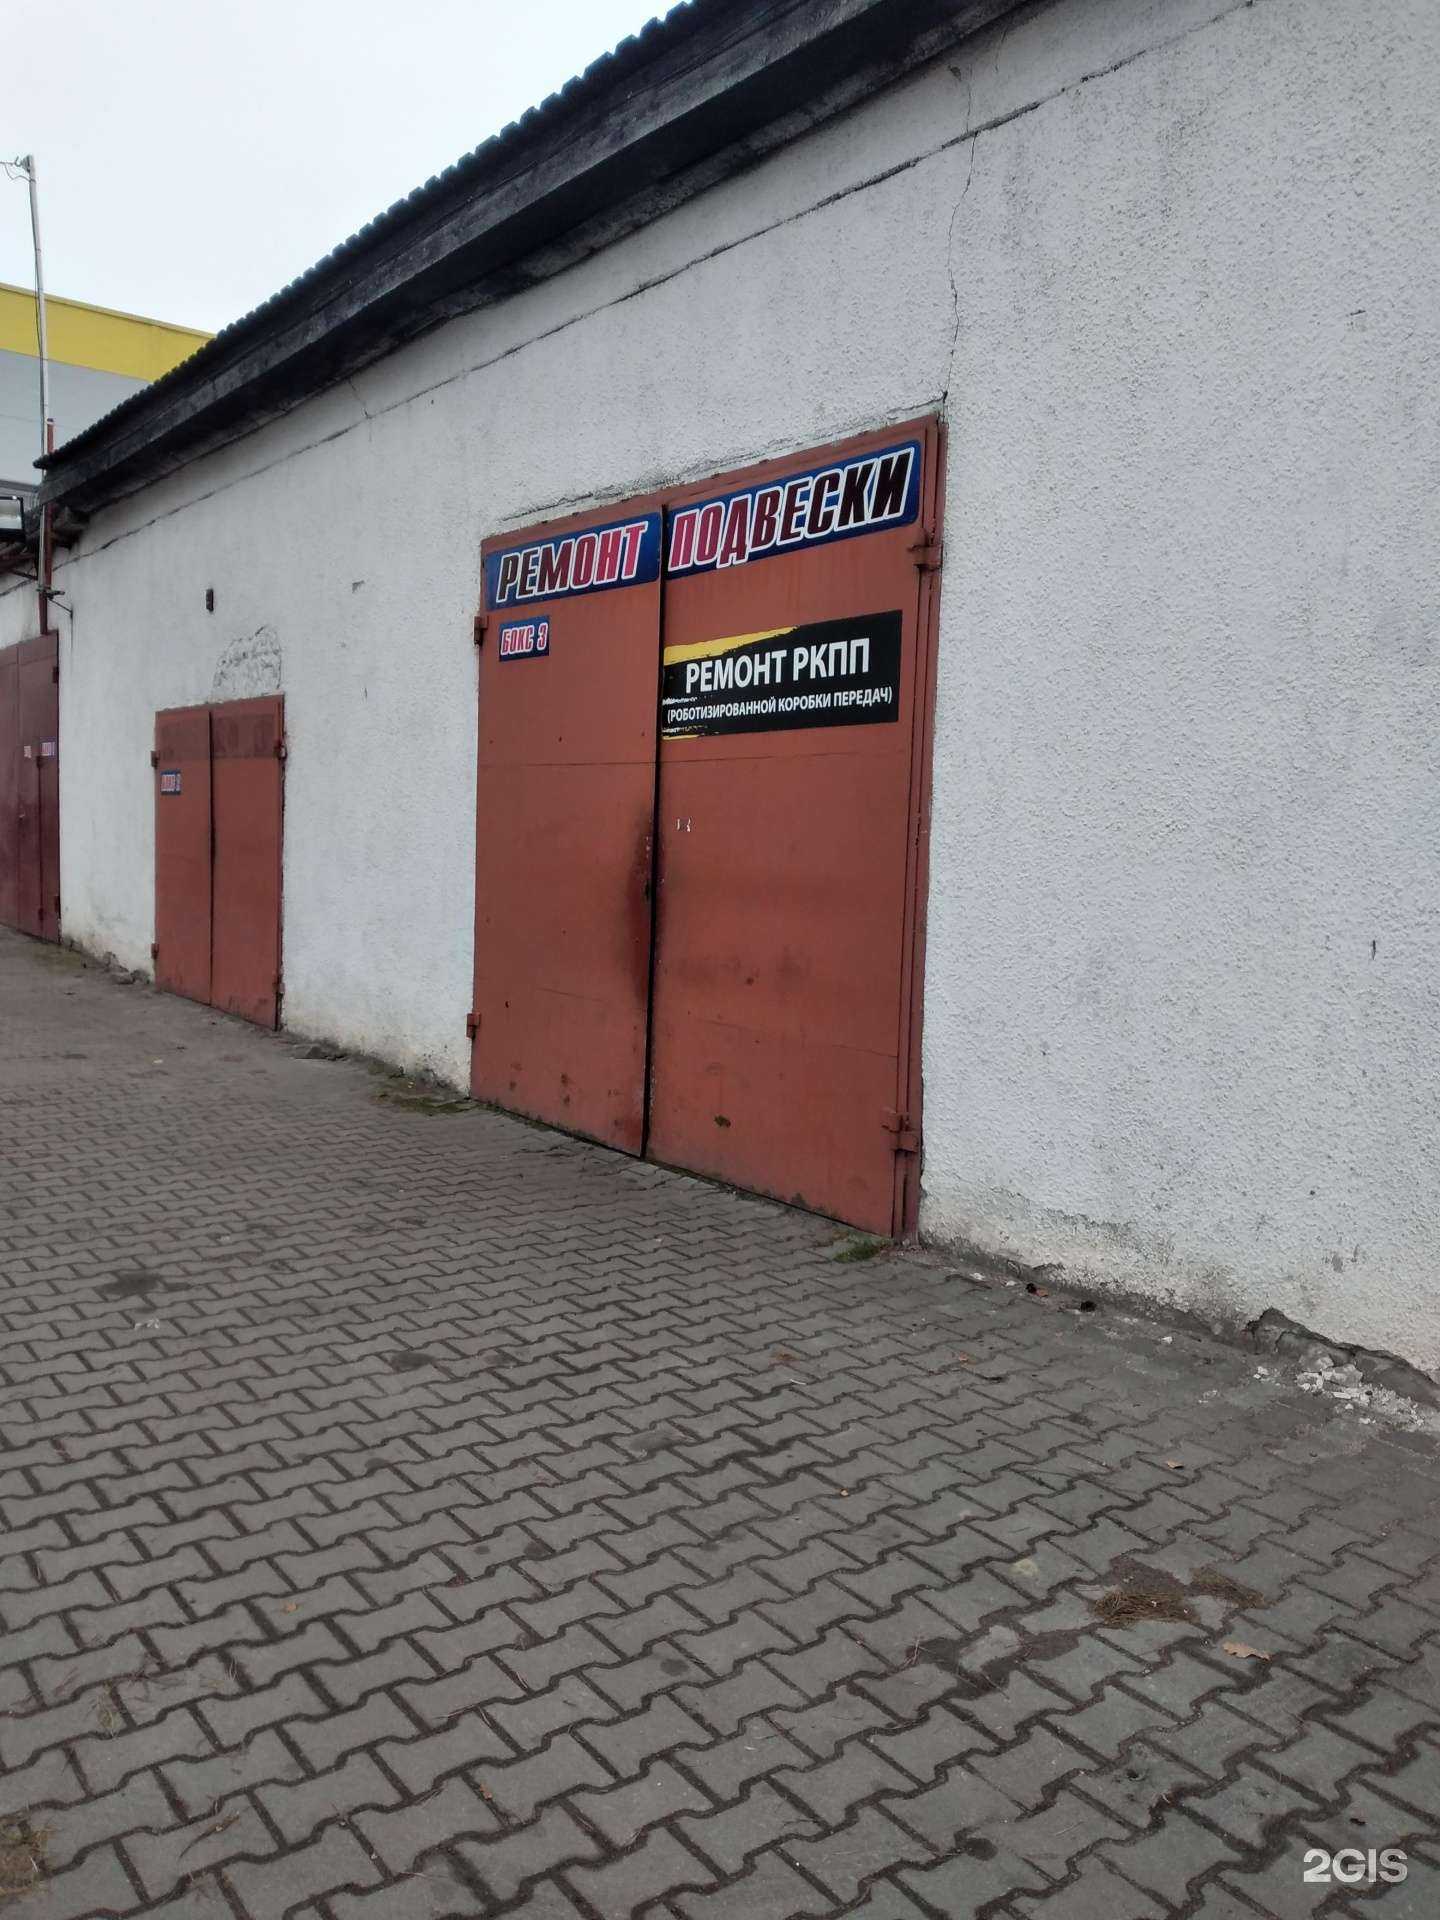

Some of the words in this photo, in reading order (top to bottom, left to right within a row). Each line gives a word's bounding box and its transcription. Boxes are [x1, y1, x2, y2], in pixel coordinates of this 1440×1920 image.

[496, 521, 649, 604] РЕМОНТ
[668, 446, 915, 569] ПОДВЕСКИ
[501, 625, 535, 655] БОКС
[537, 623, 548, 650] 3
[685, 649, 787, 694] РЕМОНТ
[792, 637, 870, 681] РКПП
[667, 696, 777, 723] (РОБОТИЗИРОВАННОЙ
[778, 691, 832, 712] КОРОБКИ
[833, 686, 893, 707] ПЕРЕДАЧ)
